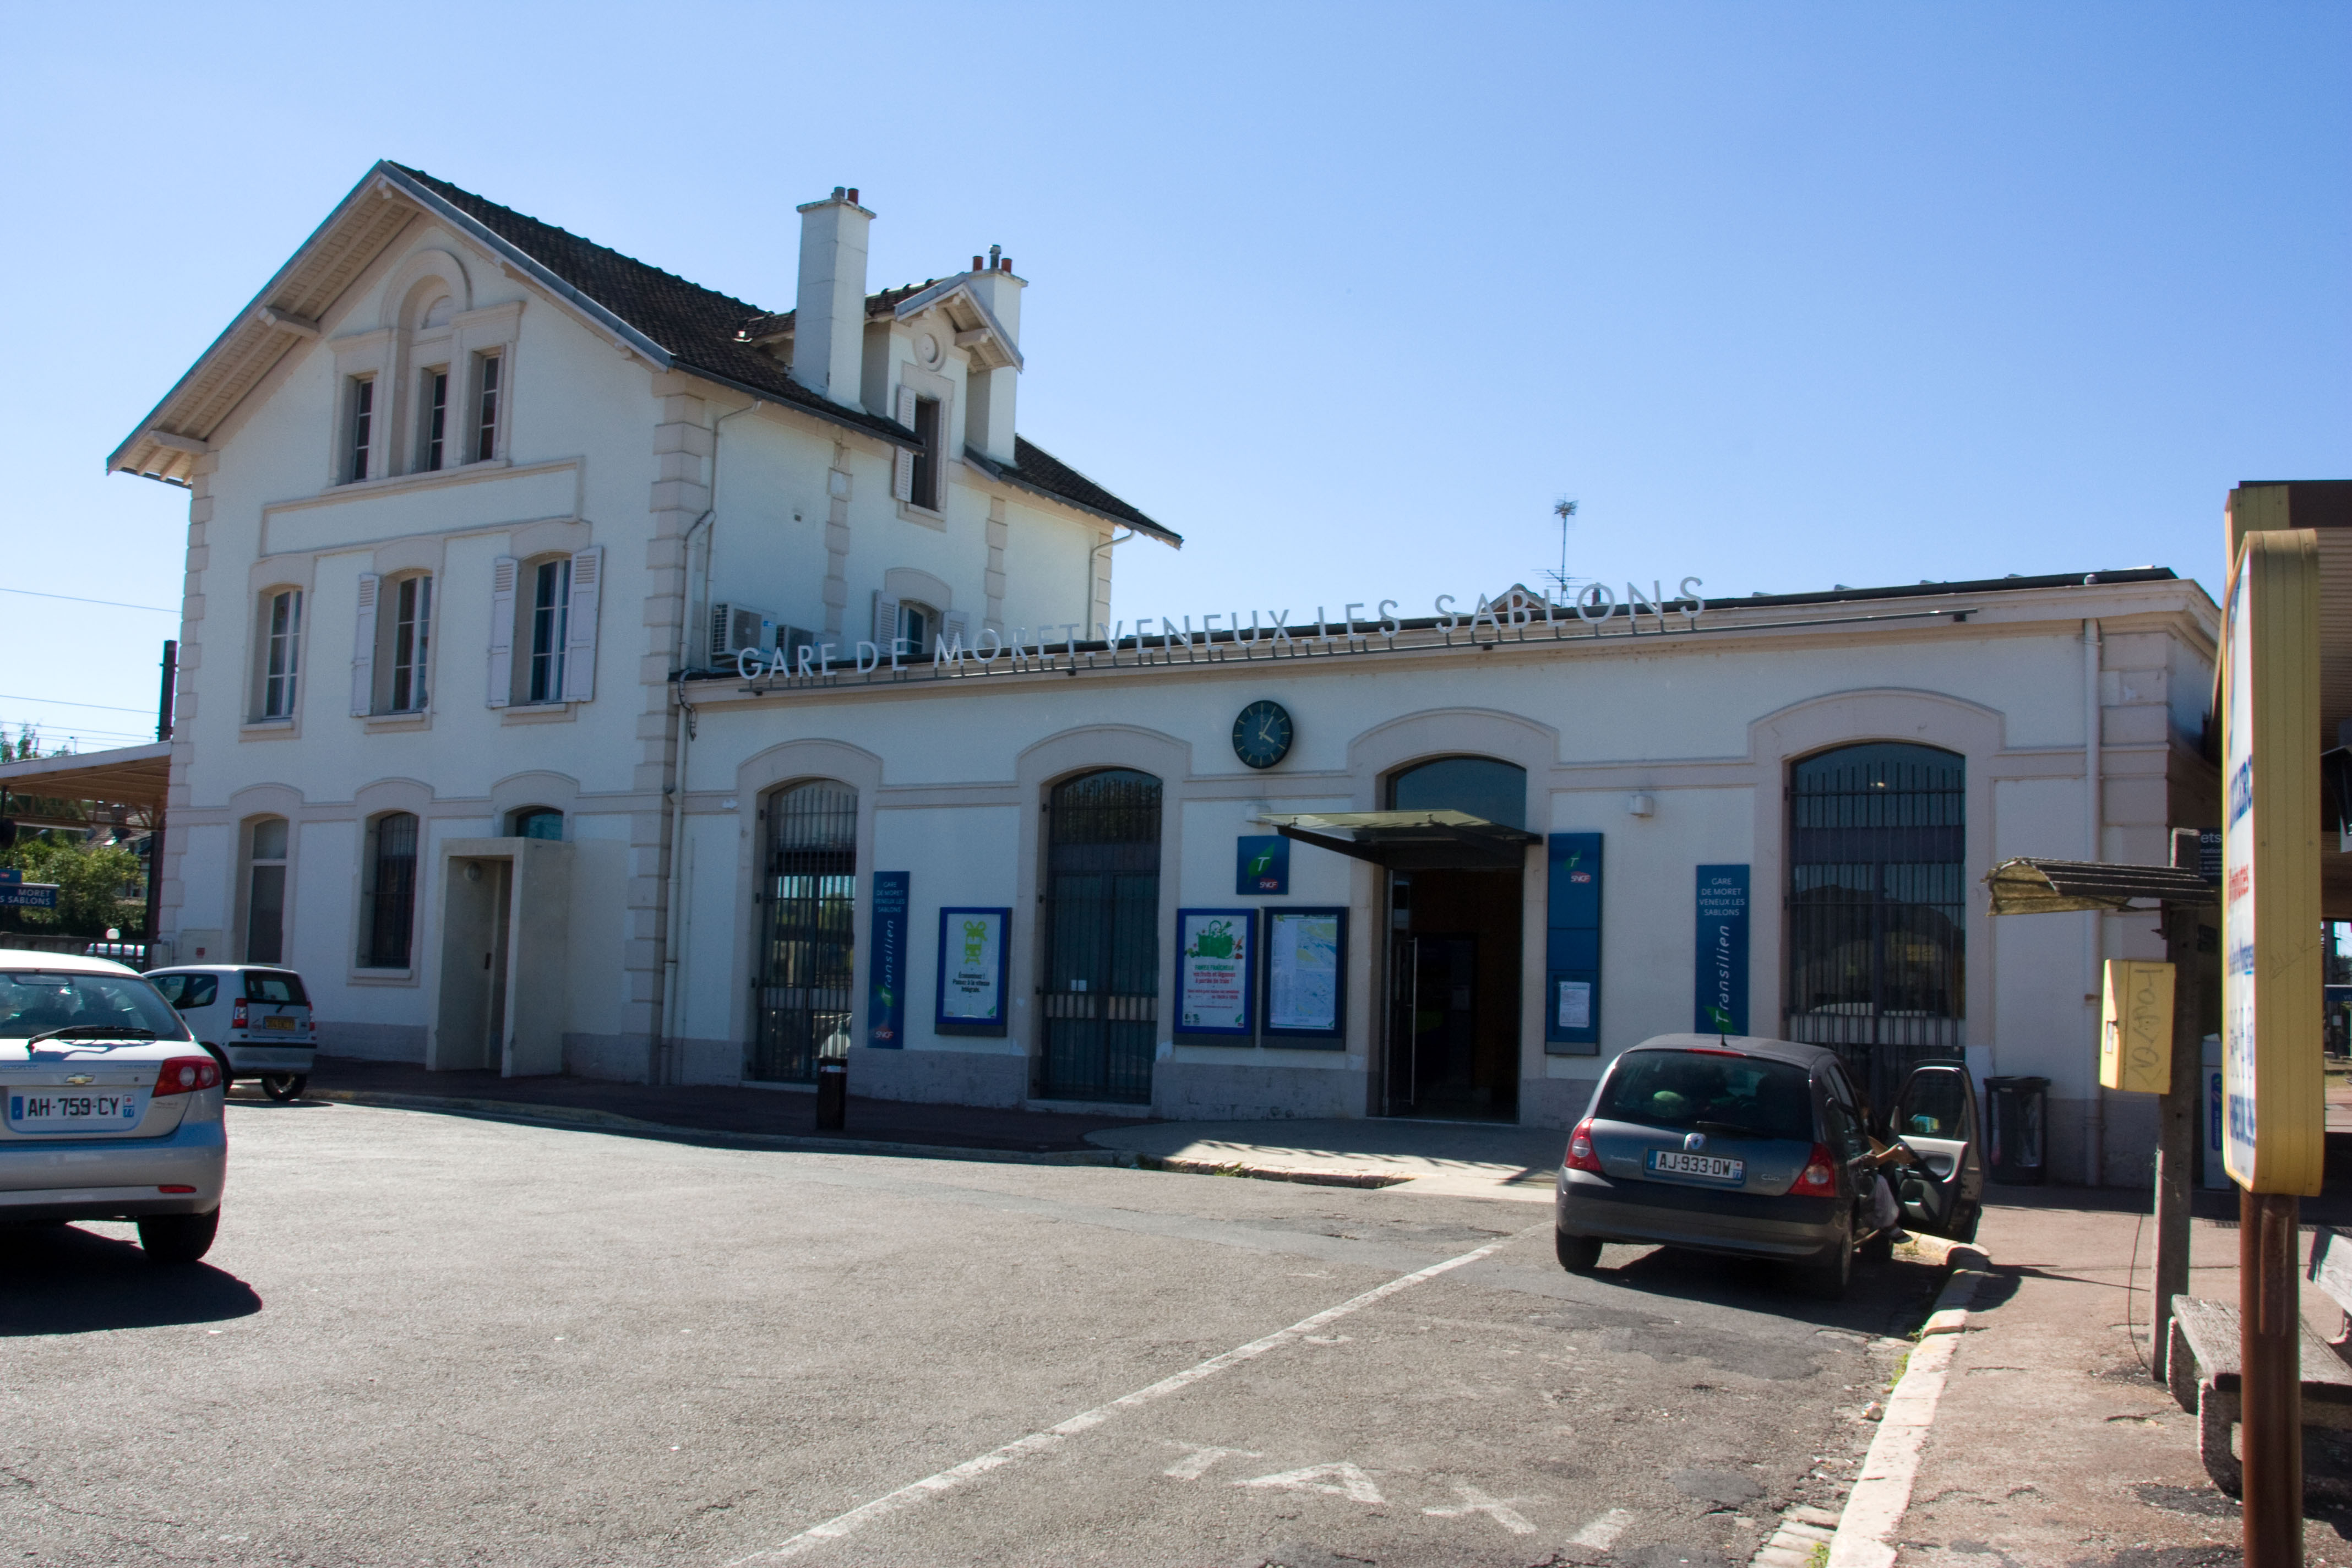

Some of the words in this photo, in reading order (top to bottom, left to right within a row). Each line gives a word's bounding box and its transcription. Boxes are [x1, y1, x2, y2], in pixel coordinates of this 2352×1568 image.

[738, 643, 836, 680] GARE
[857, 638, 908, 674] DE
[1435, 576, 1706, 635] SABLONS
[1711, 877, 1732, 885] GARE
[7, 895, 51, 906] SABLONS
[18, 889, 51, 897] MORET
[1716, 925, 1729, 1023] Transilien
[875, 1031, 894, 1039] SNCF
[28, 1097, 119, 1117] AH-759-CY
[1658, 1153, 1732, 1176] AJ-933-DW
[1163, 1439, 1635, 1550] TAXI
